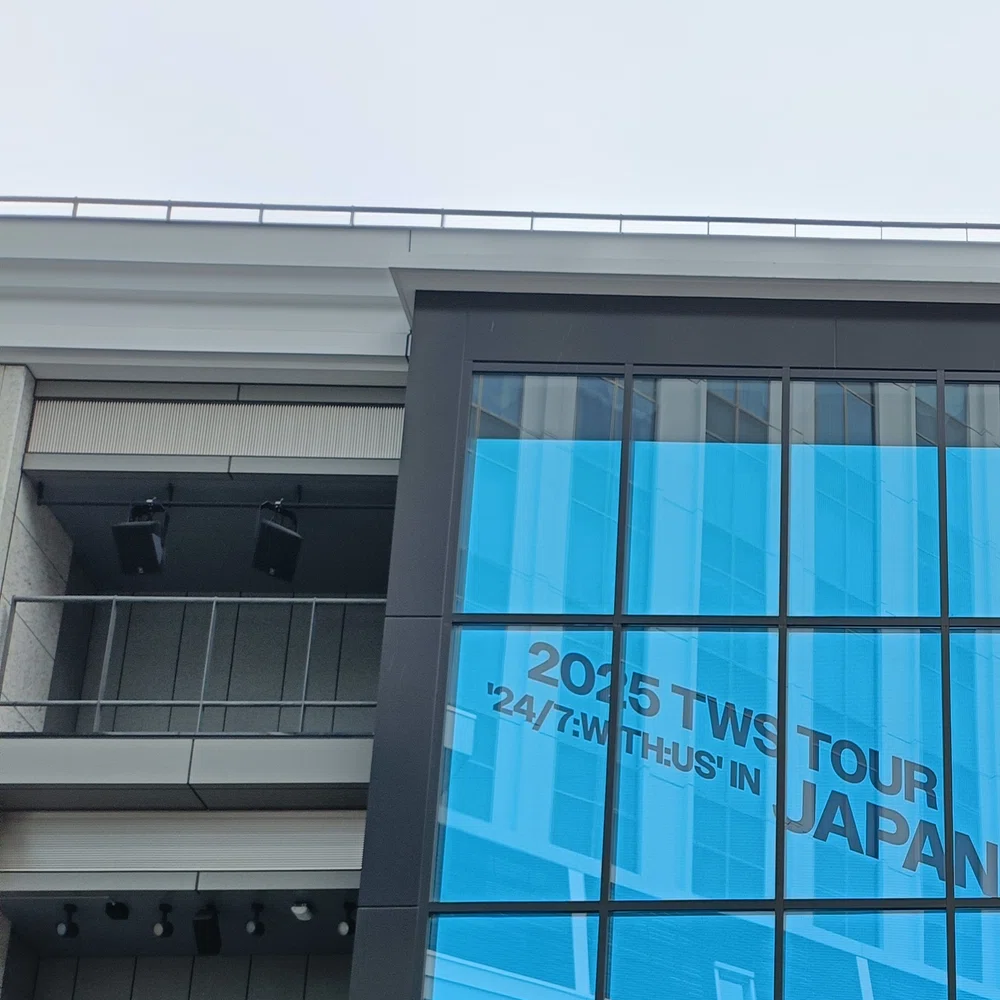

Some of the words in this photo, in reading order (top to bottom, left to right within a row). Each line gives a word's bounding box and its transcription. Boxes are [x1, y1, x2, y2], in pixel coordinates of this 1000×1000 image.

[527, 641, 661, 718] 2025
[670, 683, 779, 760] TWS
[796, 724, 939, 811] TOUR
[729, 759, 761, 797] IN
[772, 779, 999, 899] JAPAN
